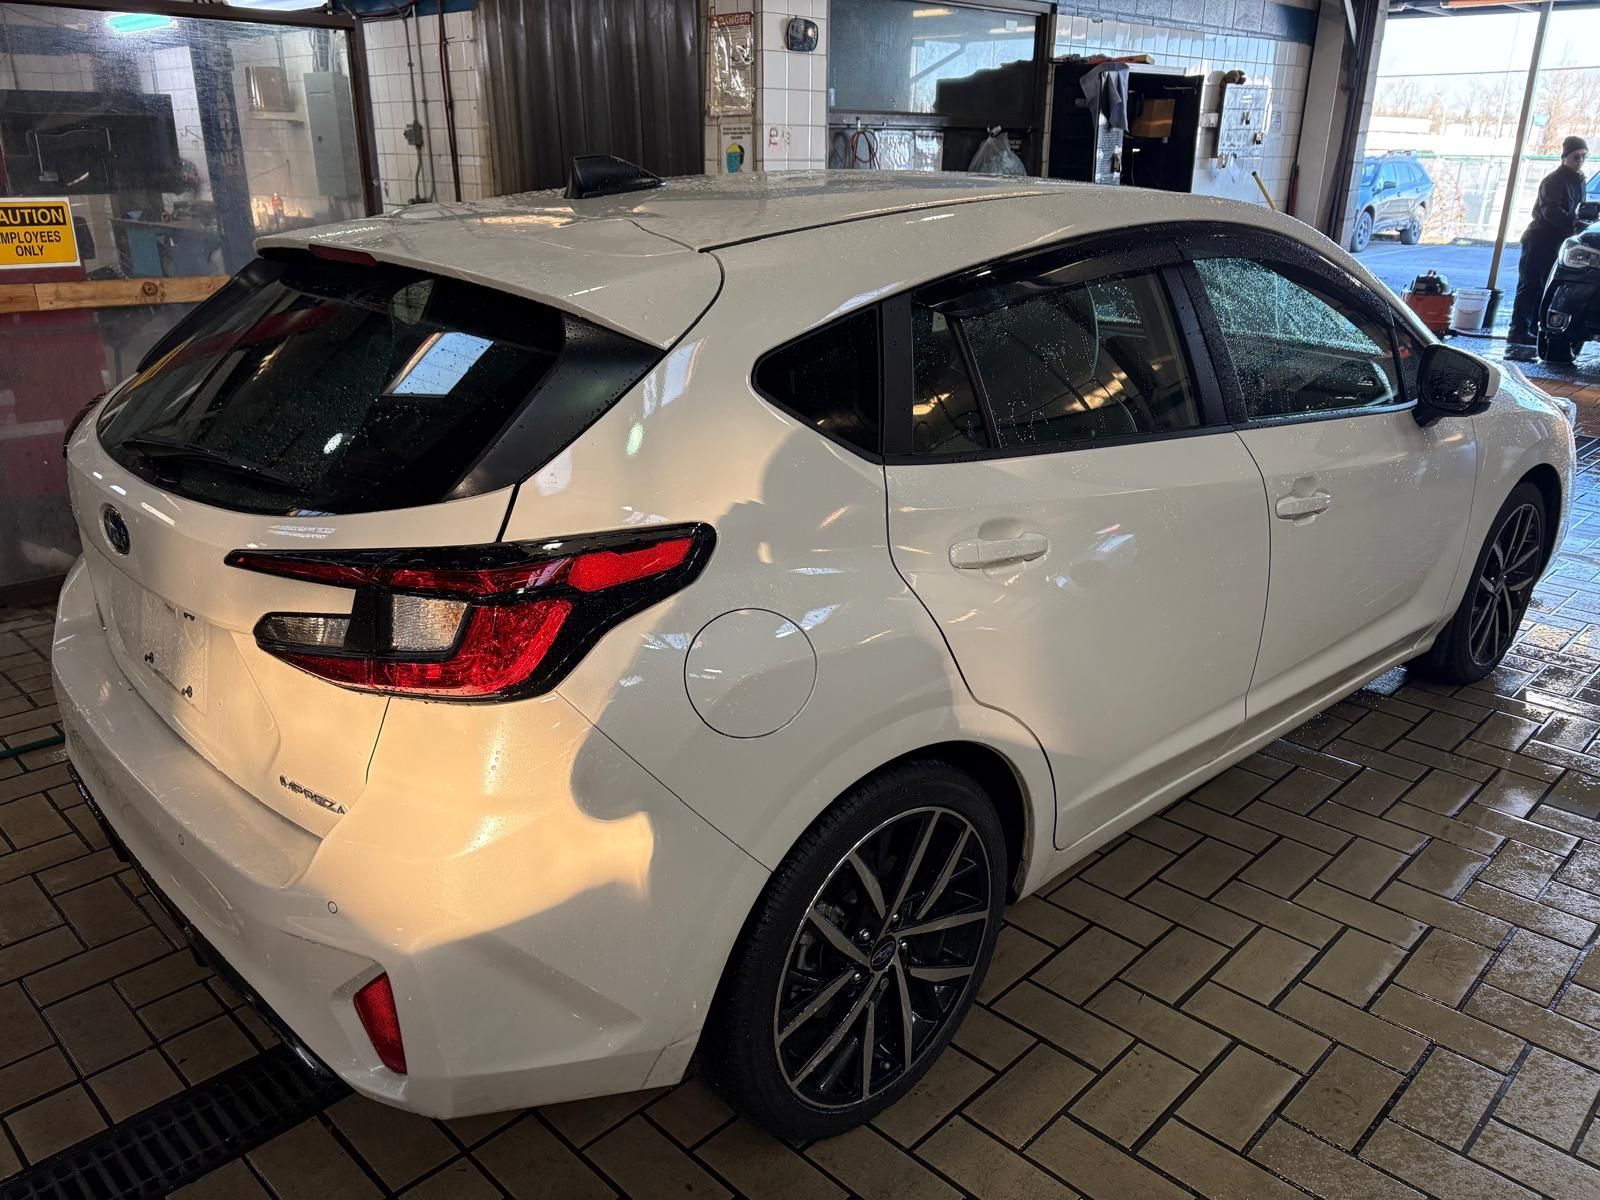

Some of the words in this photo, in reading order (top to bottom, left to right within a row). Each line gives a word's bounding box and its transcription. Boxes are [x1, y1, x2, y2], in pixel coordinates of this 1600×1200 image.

[0, 208, 64, 225] AUTION
[0, 230, 62, 245] MPLOYEES
[15, 244, 45, 257] ONLY
[279, 774, 346, 815] IMPREZA
